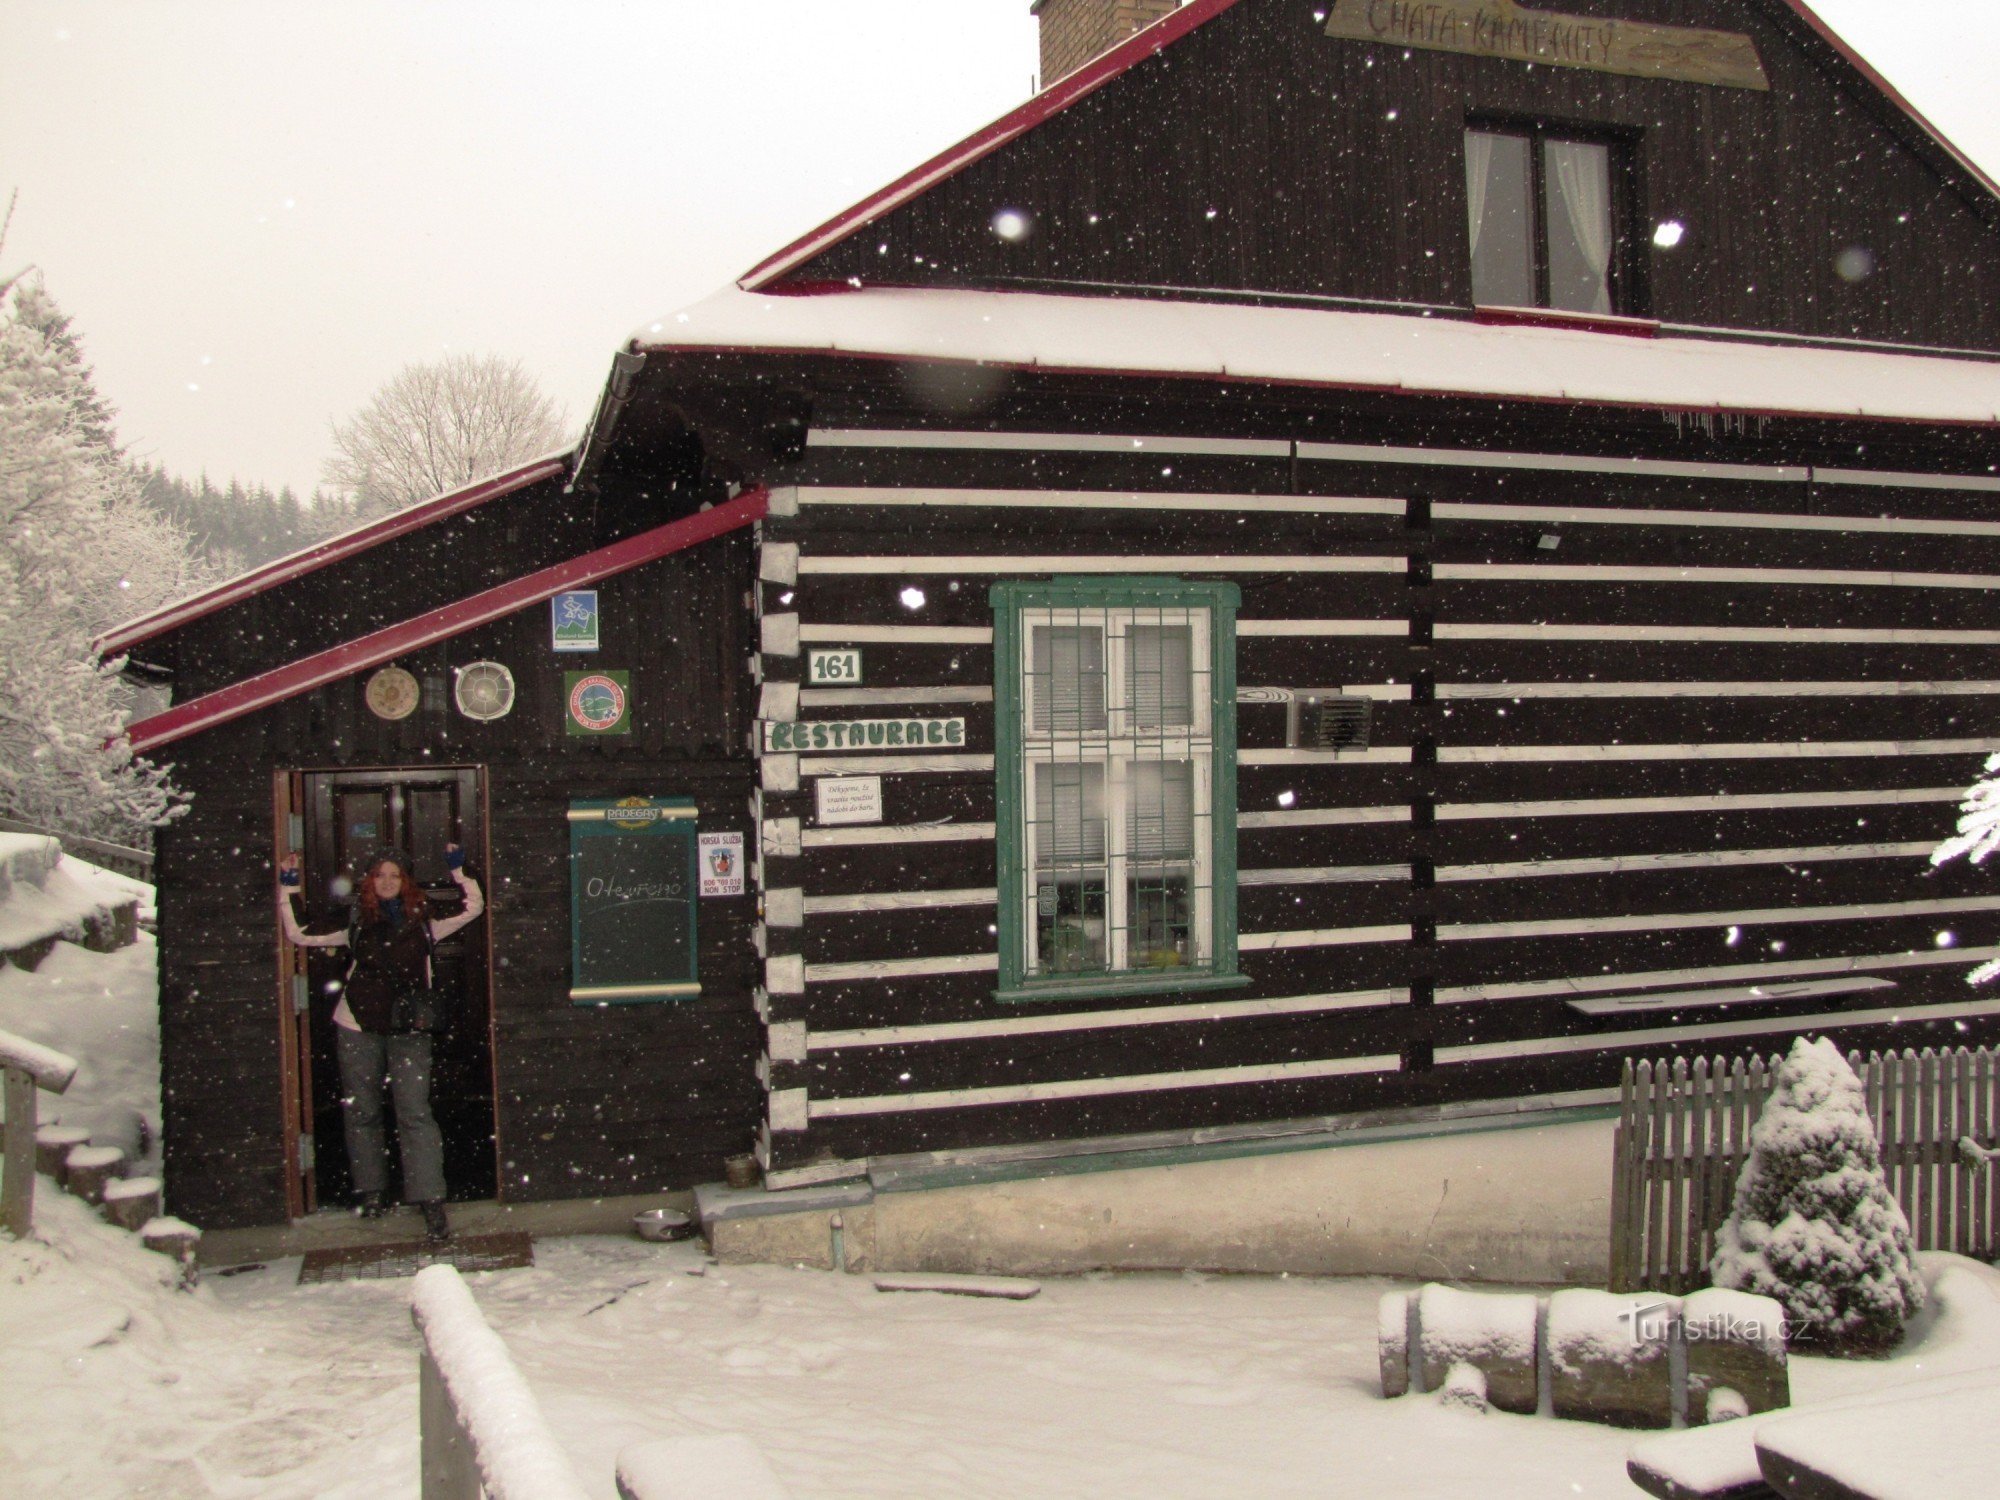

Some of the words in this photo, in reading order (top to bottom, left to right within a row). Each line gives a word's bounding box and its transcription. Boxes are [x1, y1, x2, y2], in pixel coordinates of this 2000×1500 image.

[1368, 0, 1457, 44] CHATA
[814, 655, 854, 679] 161
[771, 720, 961, 750] RESTAURACE
[607, 808, 659, 820] RADEGAST
[701, 835, 720, 845] HORSKÁ
[704, 886, 719, 894] NON
[723, 885, 741, 893] STOP
